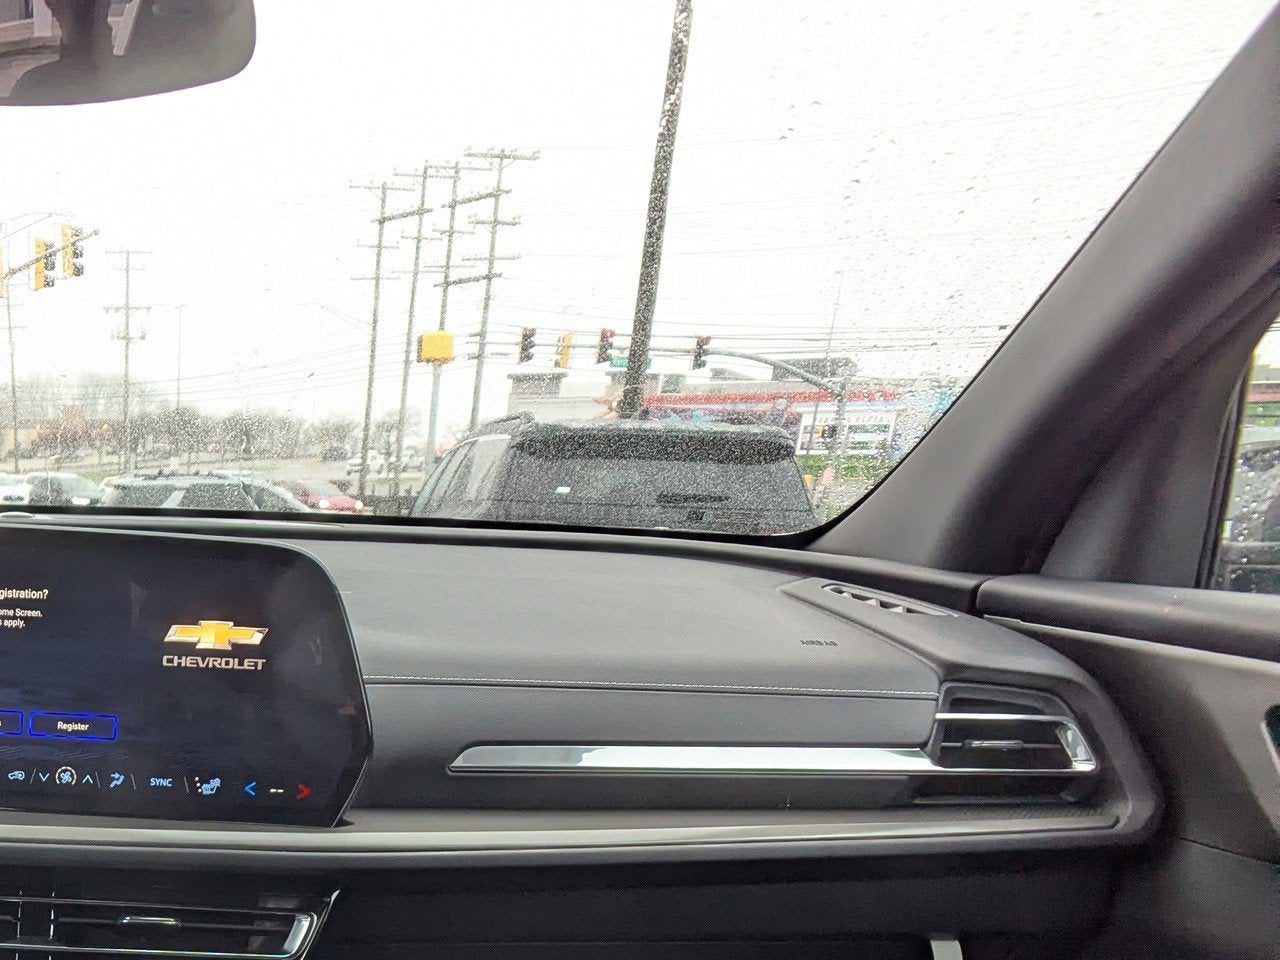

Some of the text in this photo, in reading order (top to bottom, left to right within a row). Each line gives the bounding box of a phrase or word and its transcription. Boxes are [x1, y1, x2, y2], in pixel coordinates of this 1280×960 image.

[15, 608, 43, 617] Screen.
[3, 618, 26, 628] apply.
[162, 655, 266, 670] CHEVROLET
[57, 721, 90, 731] Register
[150, 777, 172, 787] SYNC
